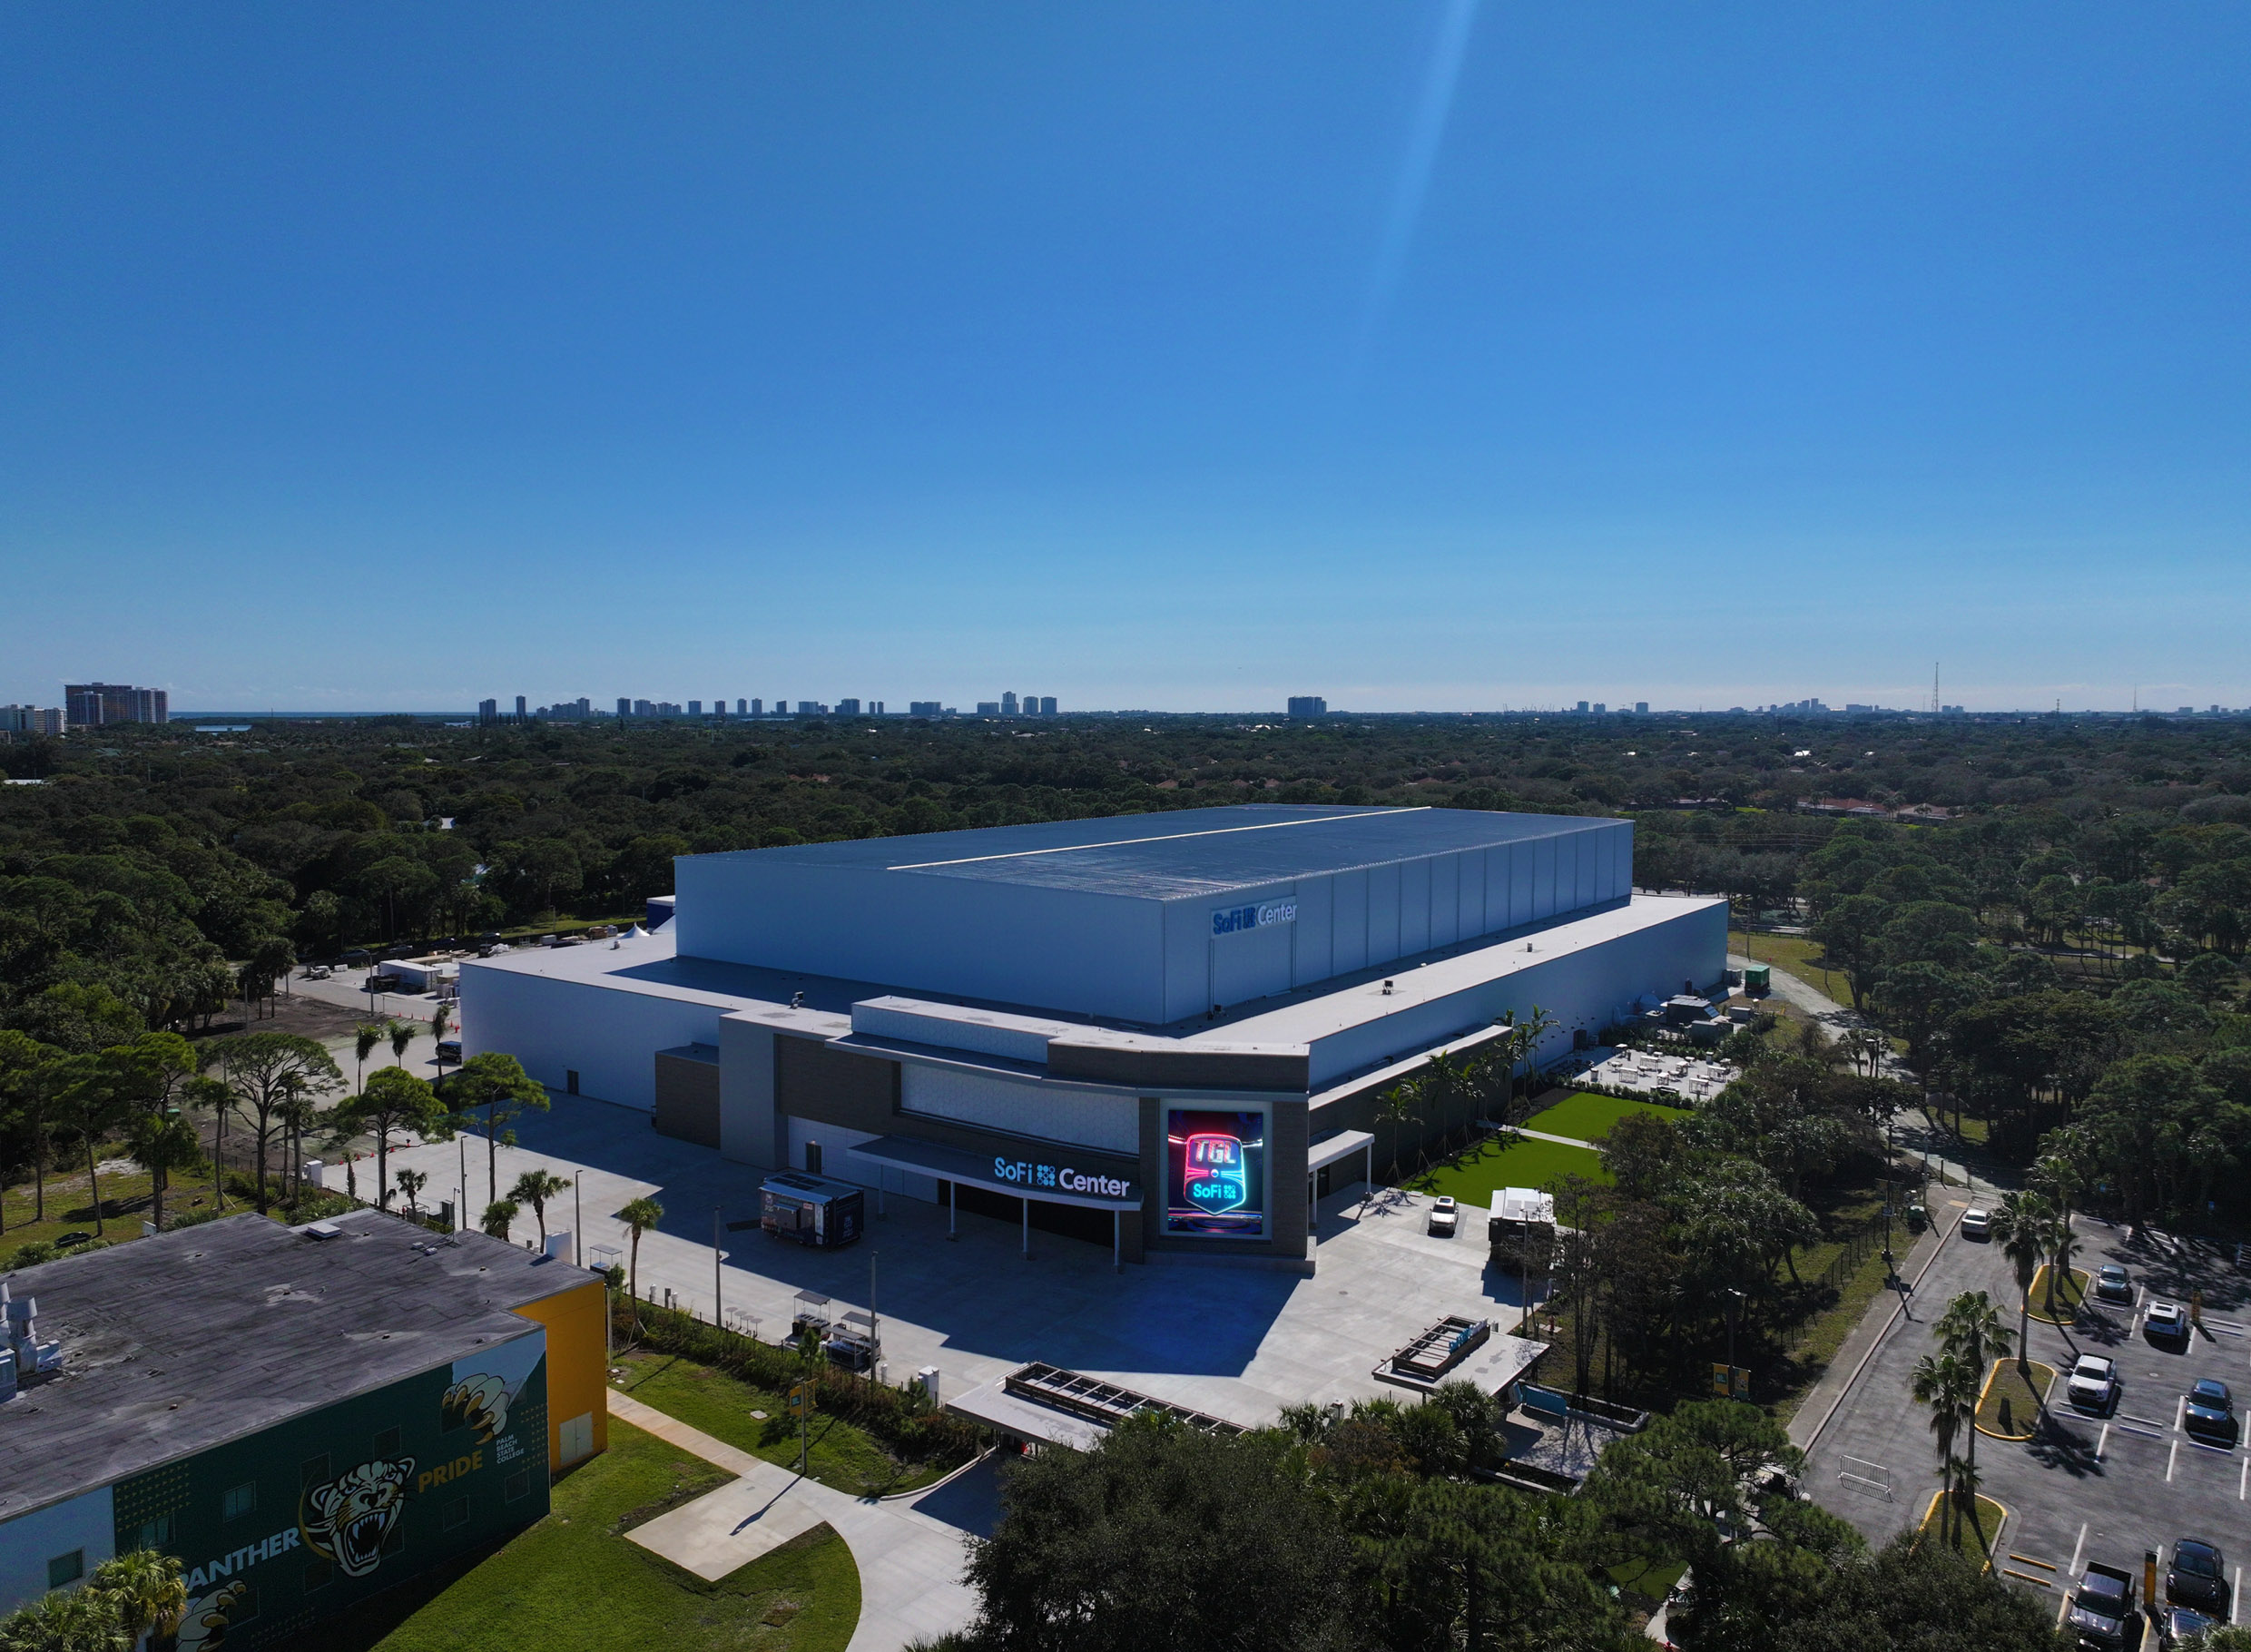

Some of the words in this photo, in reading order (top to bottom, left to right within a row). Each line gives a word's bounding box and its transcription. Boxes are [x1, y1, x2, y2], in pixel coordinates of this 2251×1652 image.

[1213, 909, 1243, 935] SoFi
[1257, 903, 1298, 926] Center
[1194, 1139, 1236, 1165] TGL
[994, 1156, 1033, 1185] SoFi
[1058, 1167, 1131, 1197] Center
[1193, 1183, 1223, 1199] SoFi
[496, 1433, 515, 1446] PALM
[496, 1438, 518, 1452] BEACH
[496, 1445, 516, 1459] STATE
[496, 1447, 525, 1464] COLLEGE
[418, 1450, 484, 1494] PRIDE
